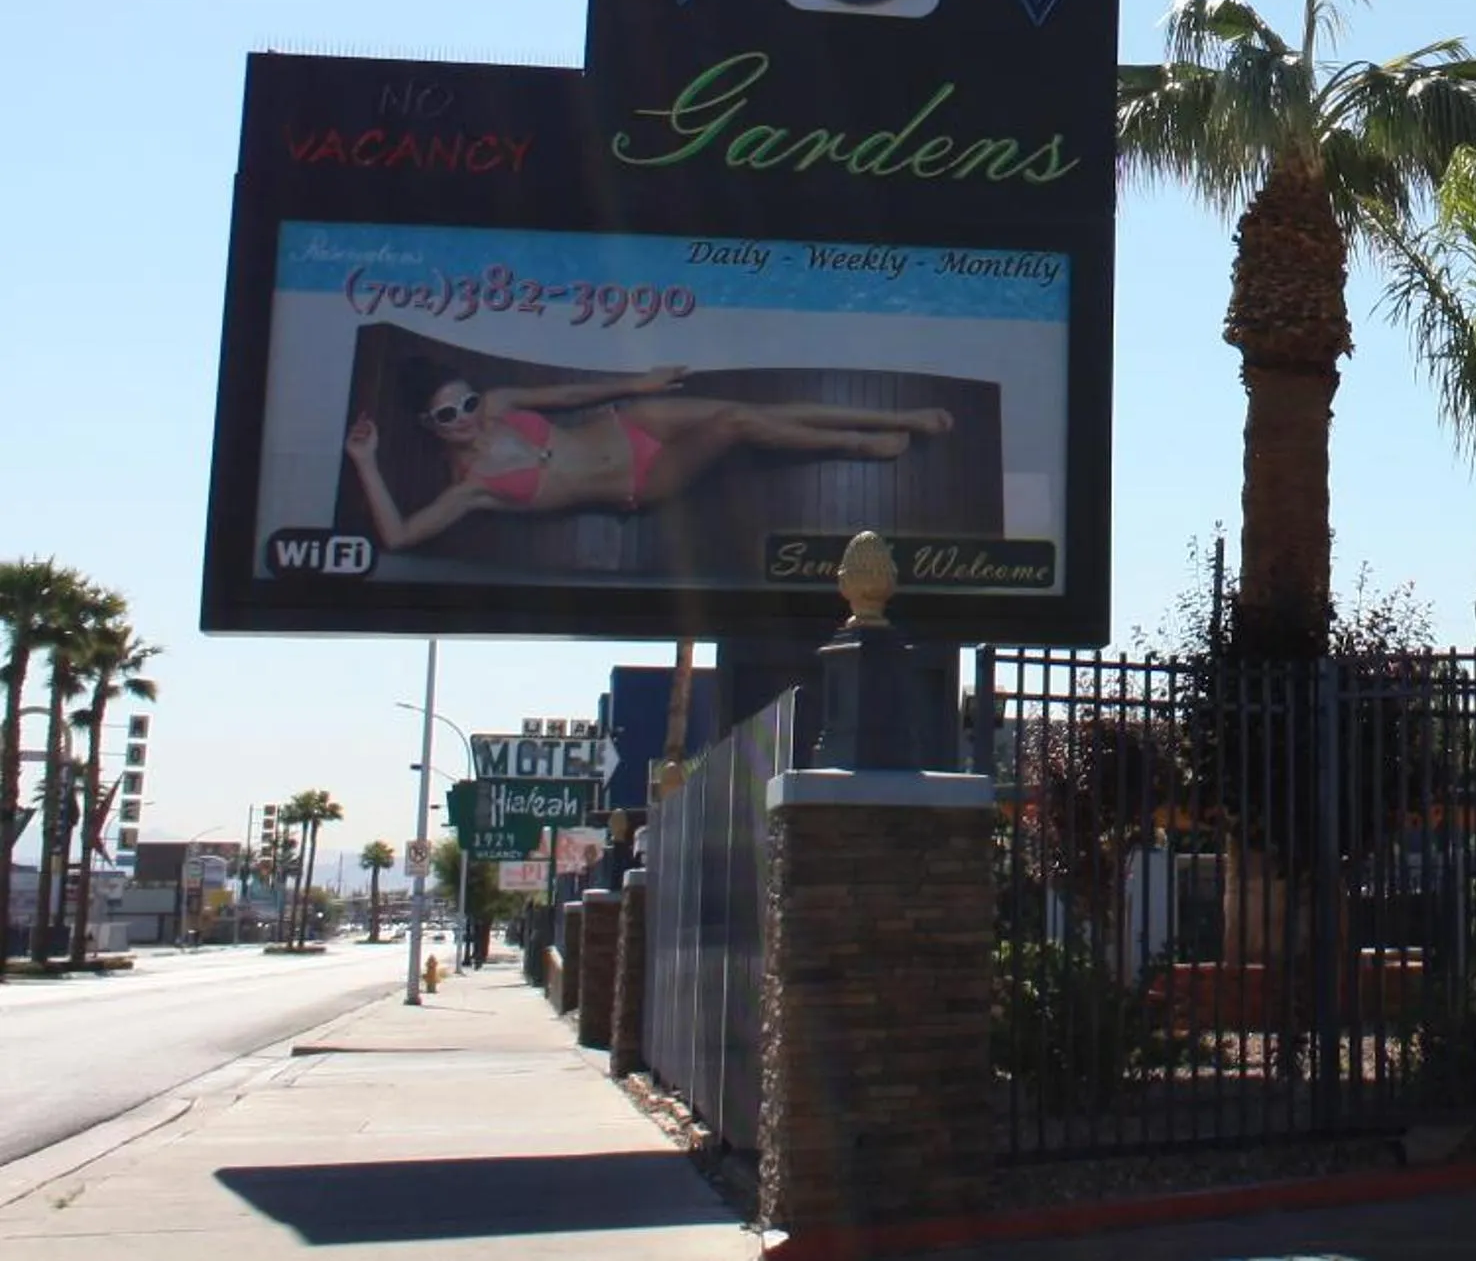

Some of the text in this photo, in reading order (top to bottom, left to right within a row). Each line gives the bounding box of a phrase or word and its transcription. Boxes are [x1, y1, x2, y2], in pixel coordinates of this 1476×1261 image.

[377, 81, 455, 117] NO
[611, 51, 1081, 182] Gardens
[284, 123, 535, 171] VACANCY
[687, 241, 770, 269] Daily
[805, 245, 906, 279] Weekly
[935, 252, 1061, 284] Monthly
[345, 264, 696, 327] (702)382-3990
[276, 540, 364, 568] WiFi
[912, 545, 1049, 581] Welcome
[478, 740, 604, 777] MOTEL
[490, 784, 579, 828] Hialeah
